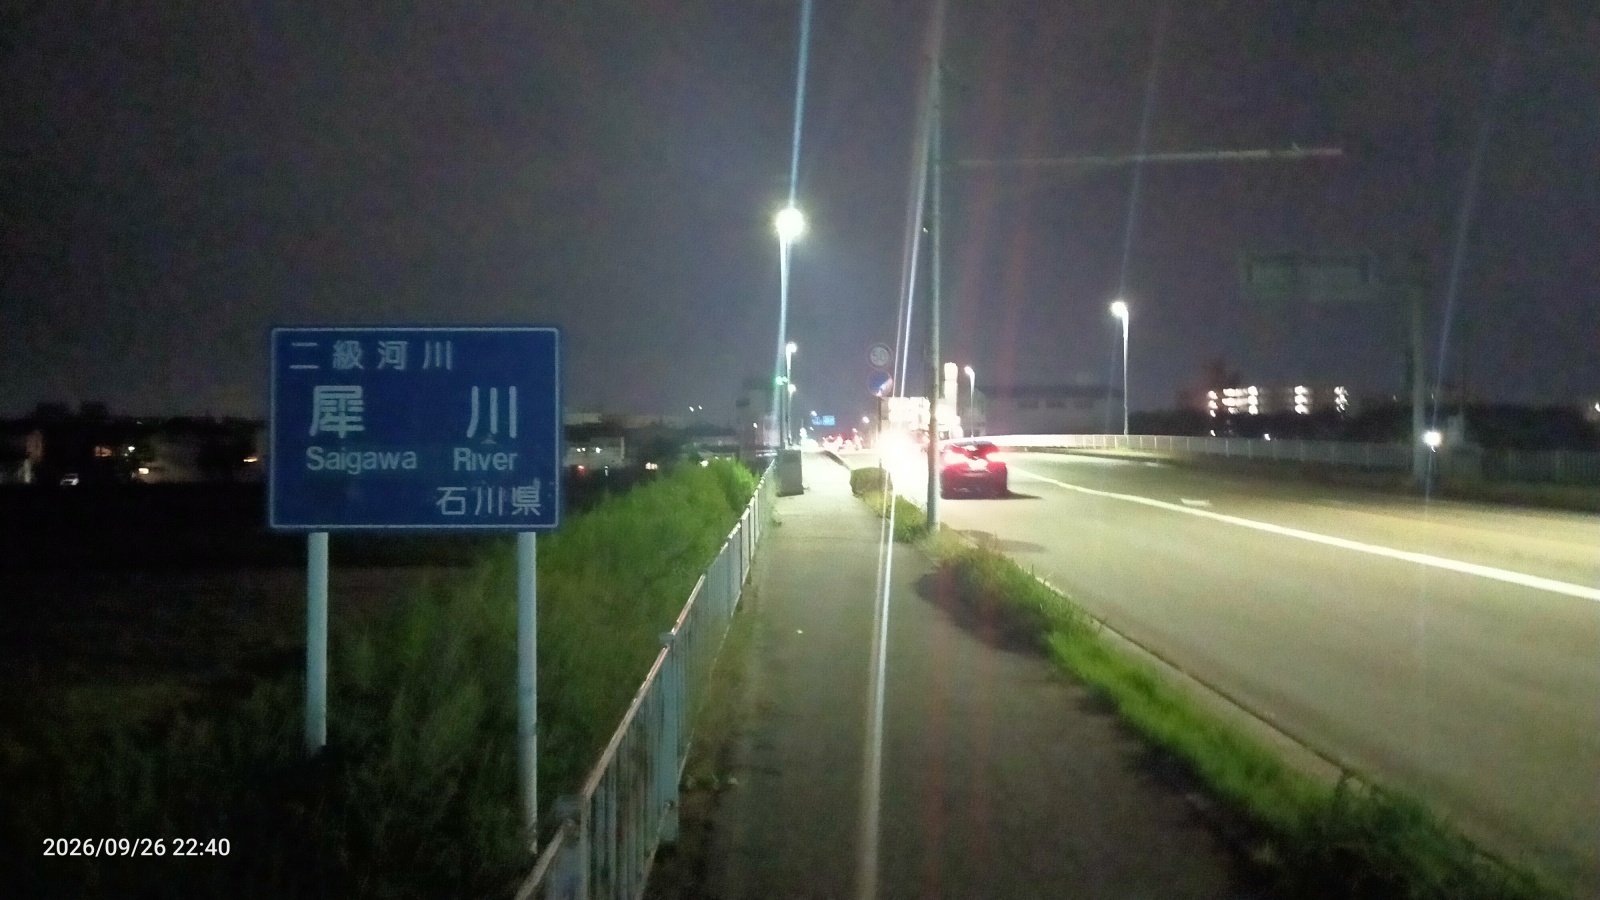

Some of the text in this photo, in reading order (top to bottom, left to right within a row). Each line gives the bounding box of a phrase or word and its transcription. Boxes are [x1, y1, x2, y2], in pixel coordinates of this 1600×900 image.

[289, 340, 453, 370] 二級河川
[306, 446, 518, 475] Saigawa River
[437, 485, 542, 516] 石川県
